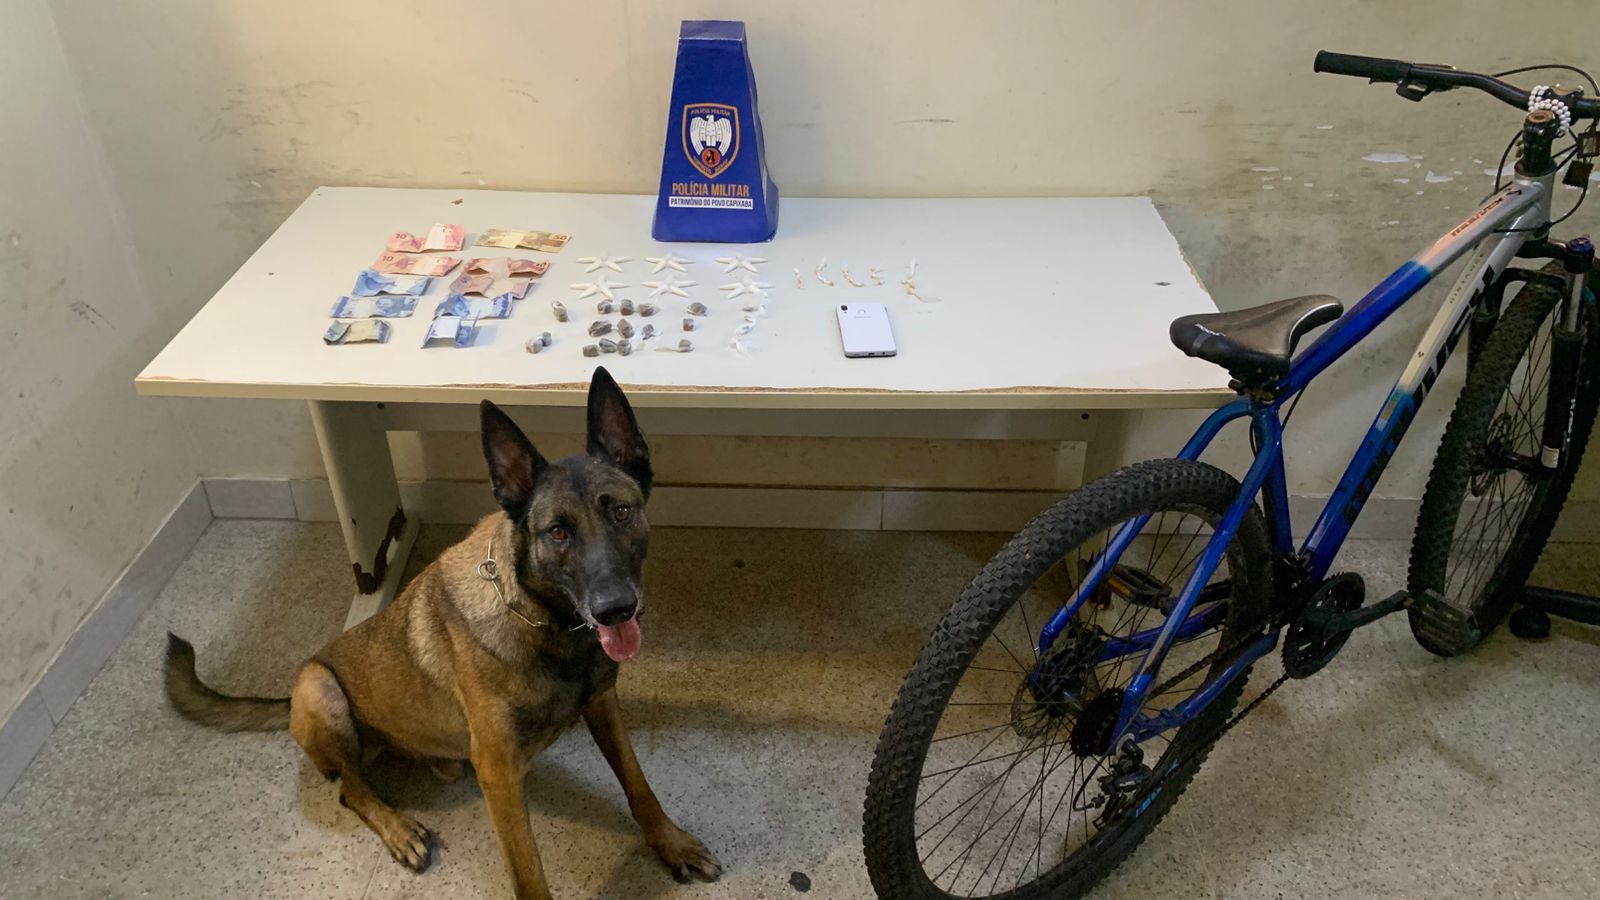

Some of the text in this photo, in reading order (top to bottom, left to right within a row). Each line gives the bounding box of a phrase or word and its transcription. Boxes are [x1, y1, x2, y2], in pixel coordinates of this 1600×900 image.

[672, 181, 750, 197] POLÍCIA MILITAR
[671, 198, 702, 206] PATRIMÔNIO
[711, 199, 725, 207] POVO
[726, 200, 752, 208] CAPIXABA
